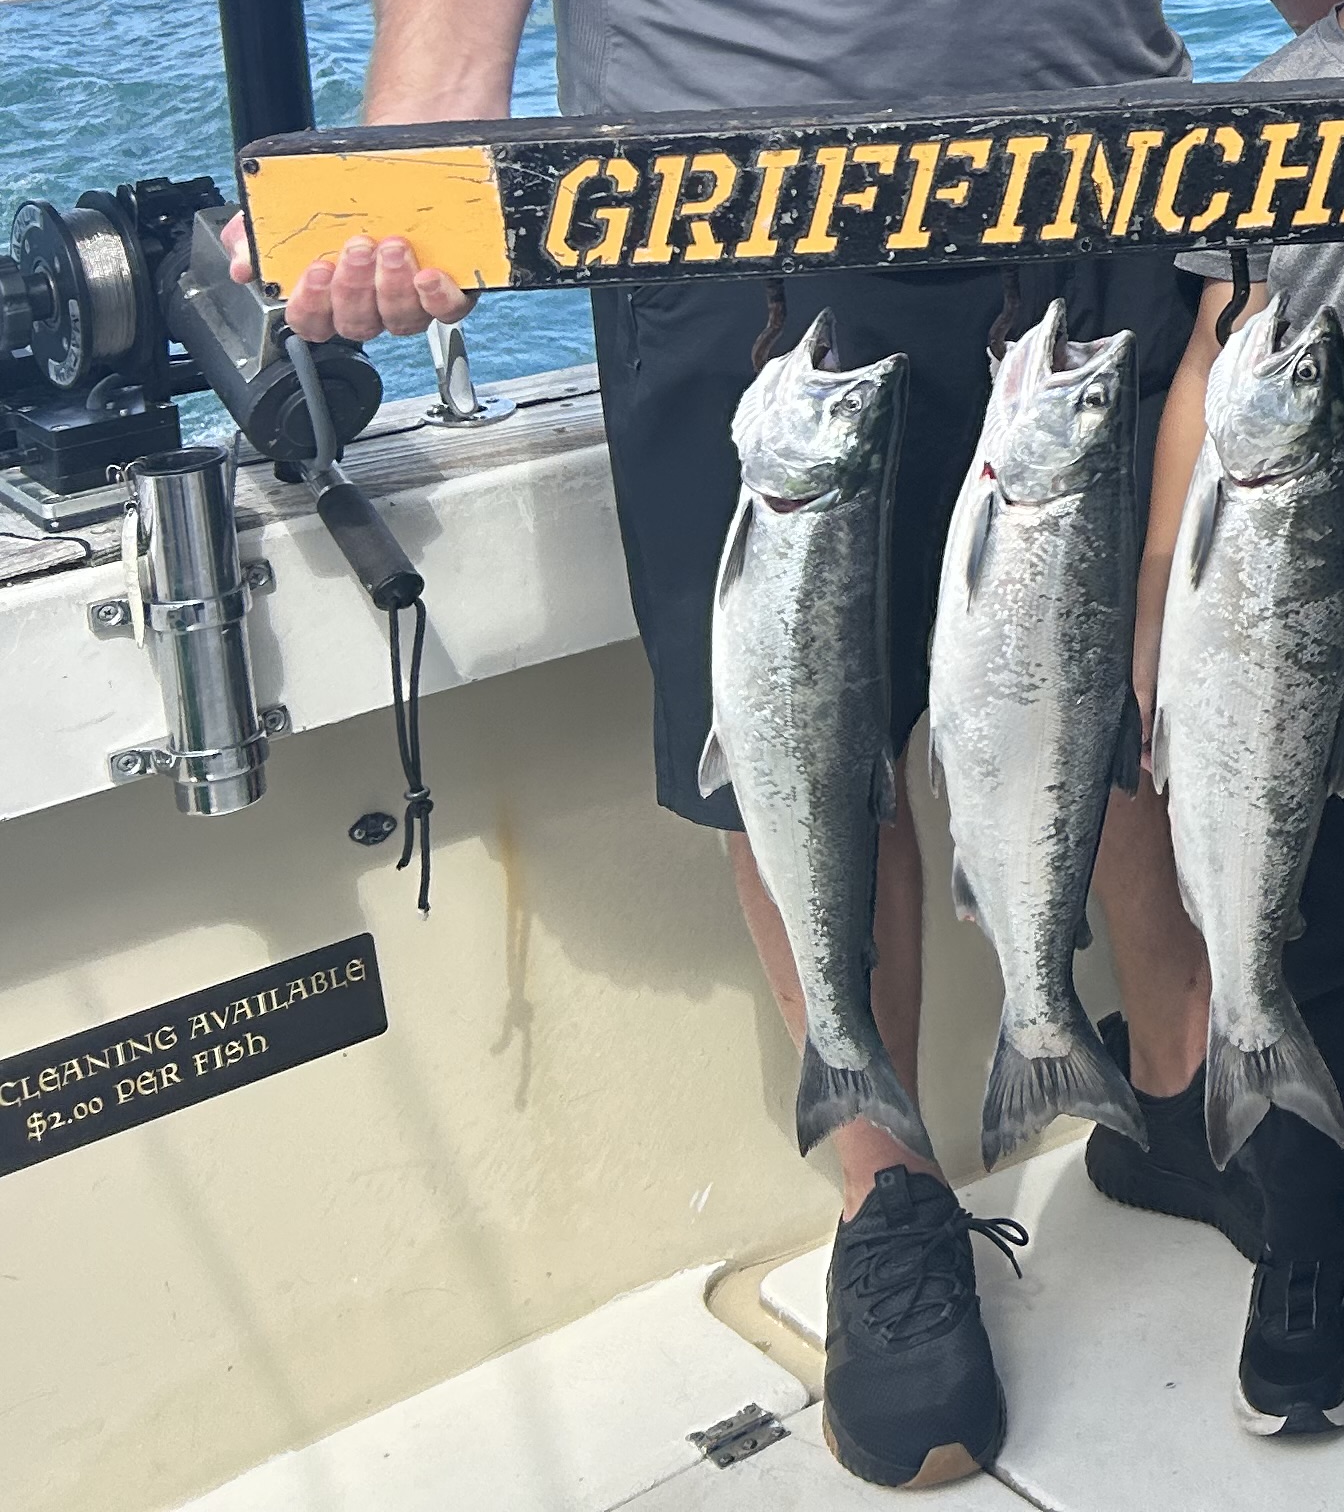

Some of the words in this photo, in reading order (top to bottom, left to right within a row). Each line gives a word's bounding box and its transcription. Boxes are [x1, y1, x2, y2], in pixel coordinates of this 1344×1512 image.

[0, 1024, 178, 1108] CLEANING
[189, 957, 366, 1040] AVAILABLE
[26, 1096, 104, 1142] $2.00
[112, 1062, 184, 1106] PER
